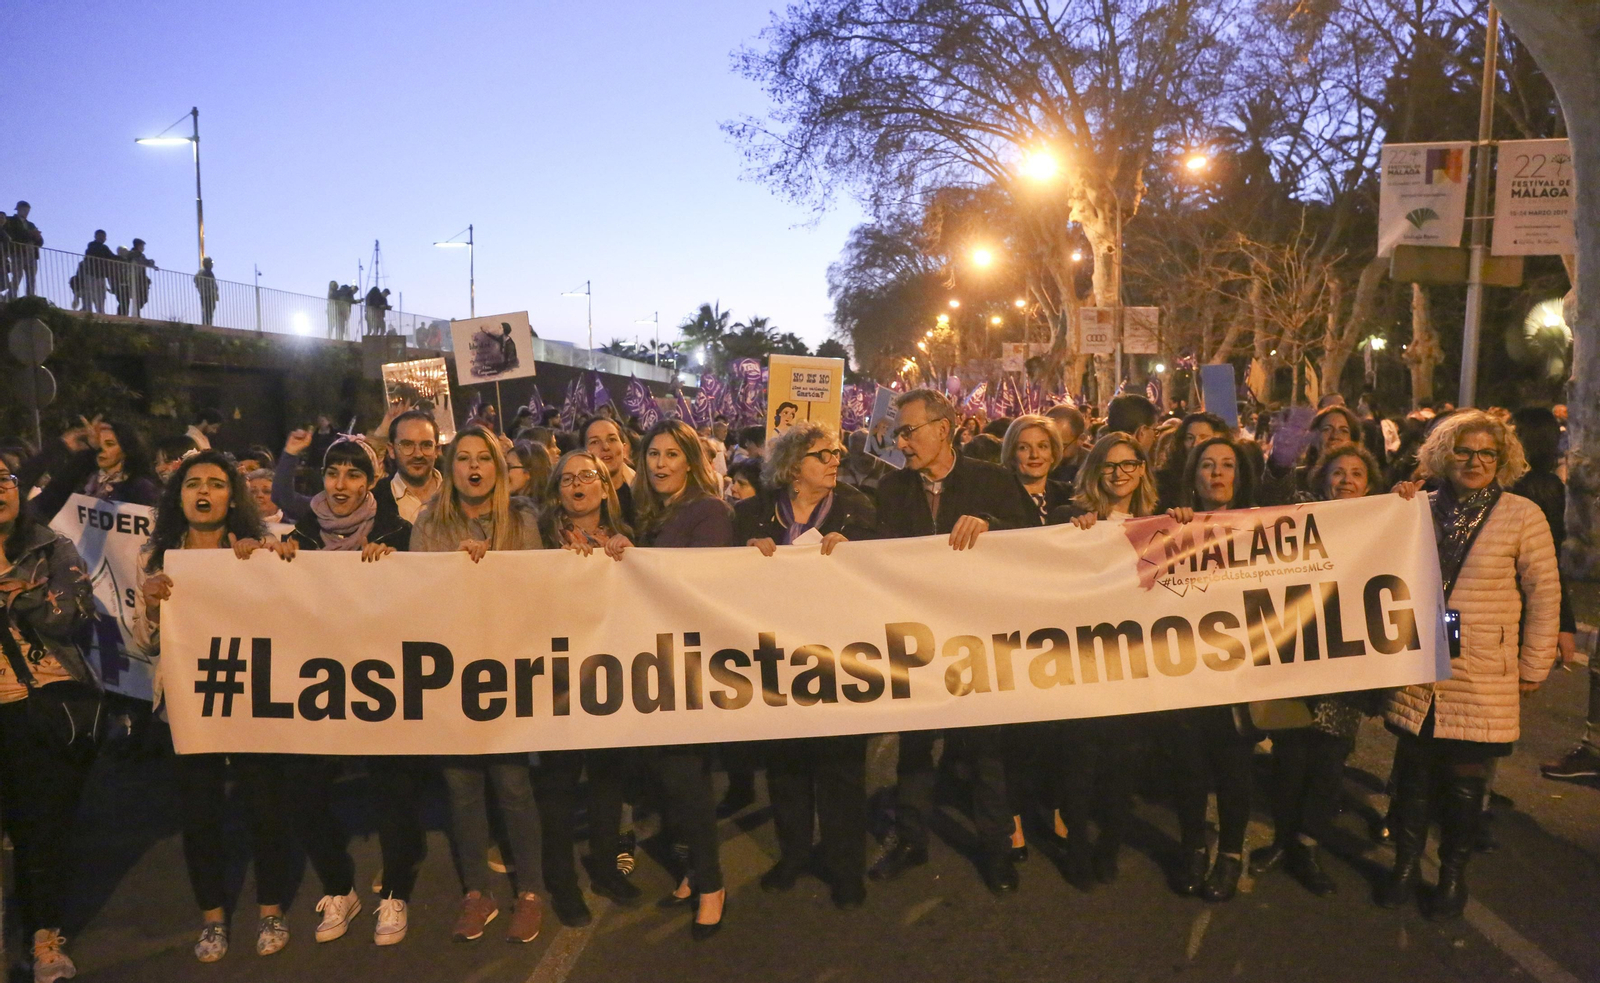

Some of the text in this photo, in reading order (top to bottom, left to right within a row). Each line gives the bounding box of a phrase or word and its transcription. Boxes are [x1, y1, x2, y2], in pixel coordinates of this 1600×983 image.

[1514, 154, 1546, 178] 22
[793, 372, 830, 384] NO ES NO
[1161, 512, 1329, 575] MÁLAGA
[194, 573, 1421, 722] #LasPeriodistasParamosMLG
